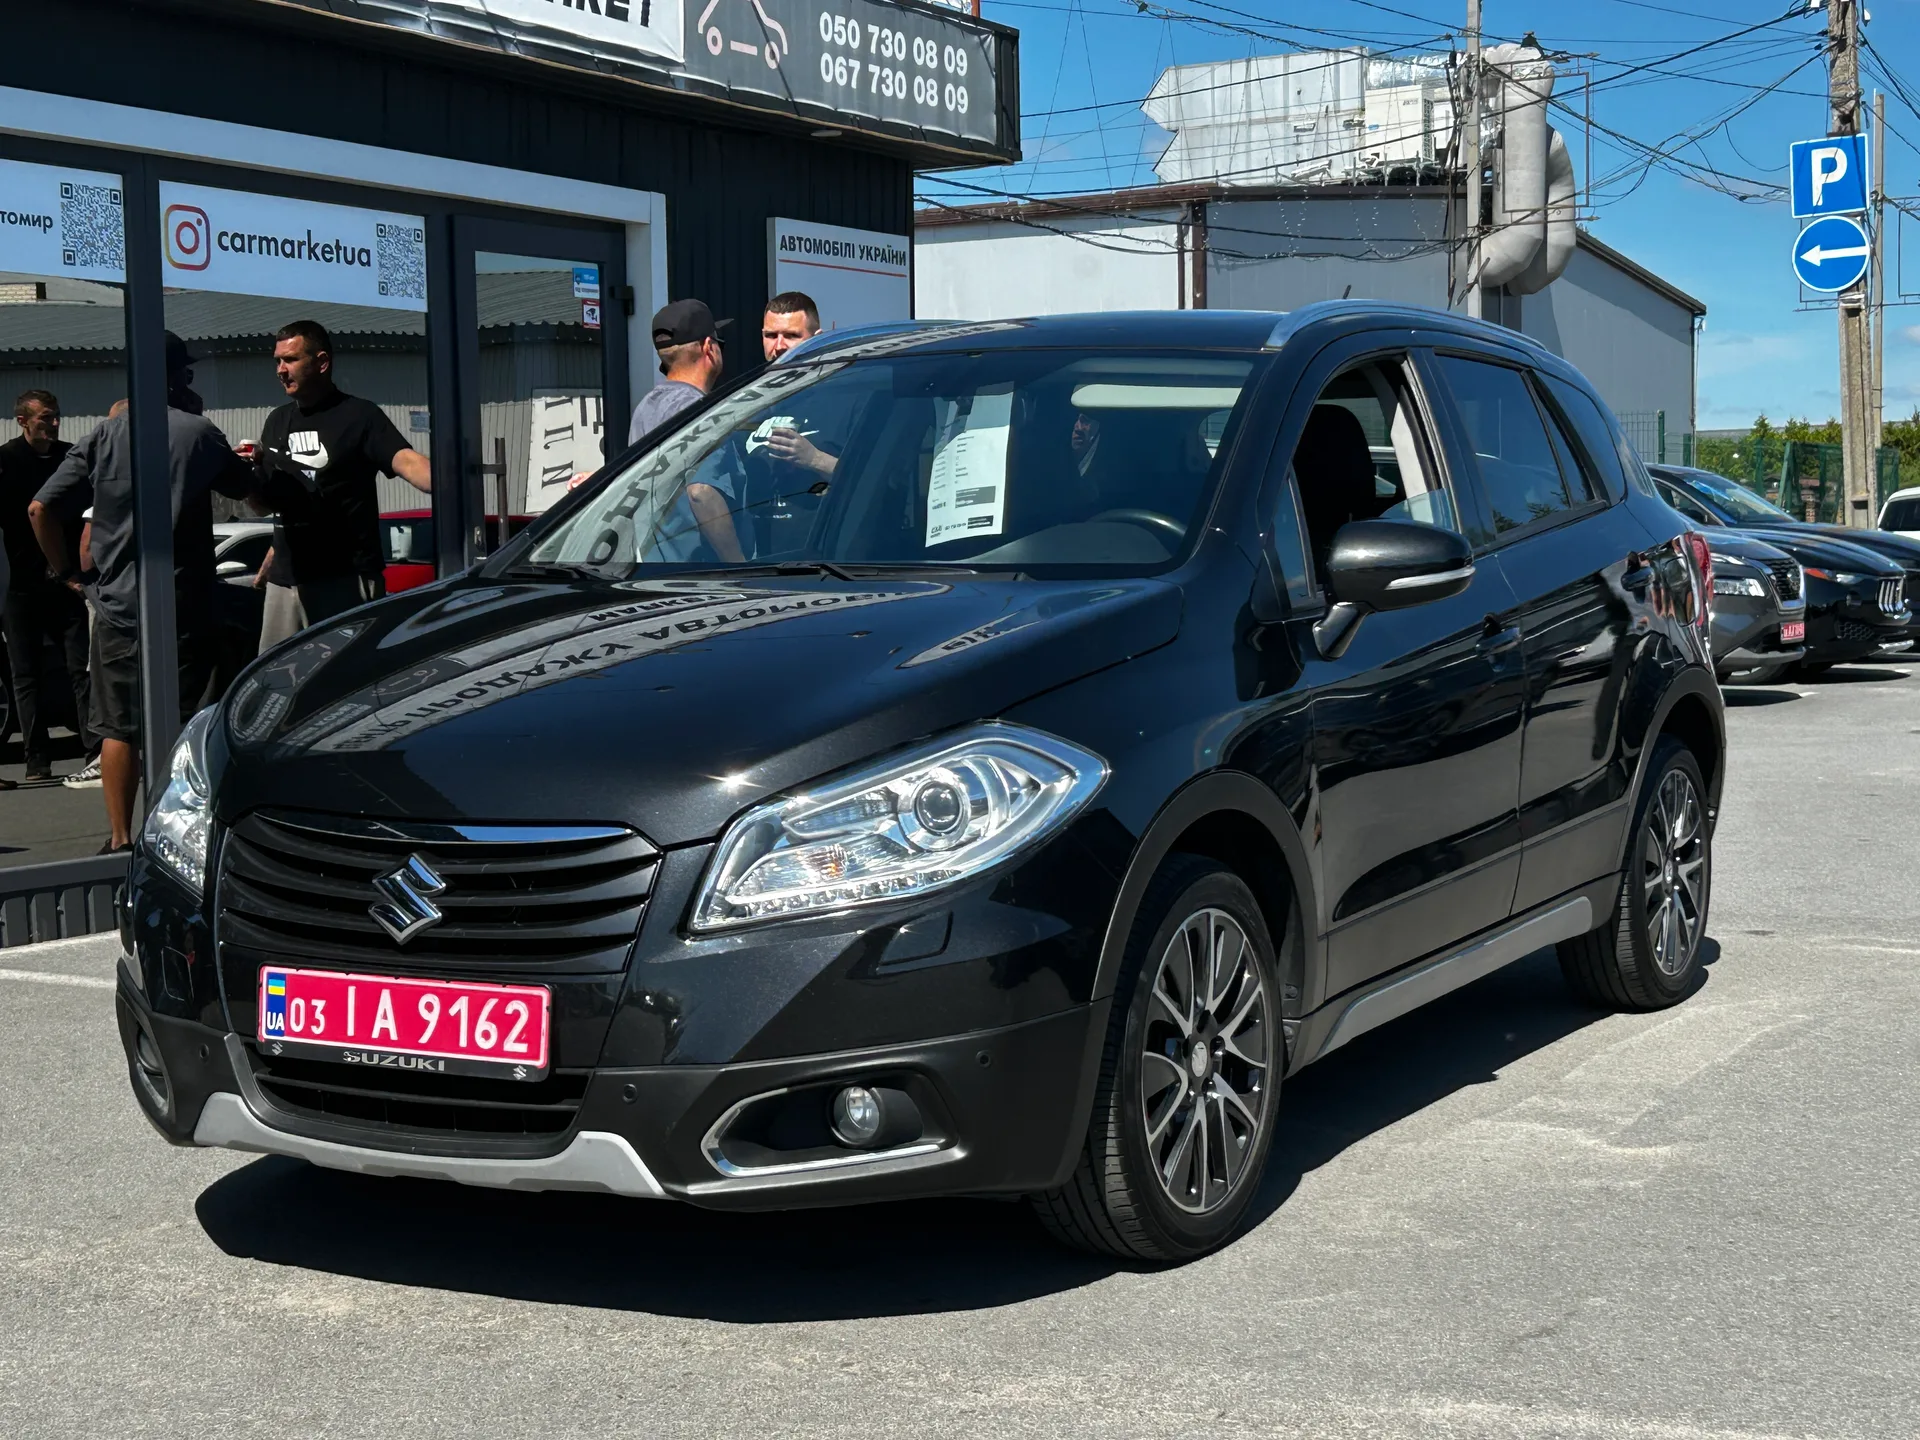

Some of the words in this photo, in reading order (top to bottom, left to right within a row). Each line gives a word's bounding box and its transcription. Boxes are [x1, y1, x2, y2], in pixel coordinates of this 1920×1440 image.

[819, 11, 861, 49] 050
[867, 24, 907, 61] 730
[912, 36, 938, 69] 08
[943, 44, 968, 77] 09
[820, 52, 861, 89] 067
[868, 64, 907, 100] 730
[913, 75, 939, 107] 08
[944, 82, 969, 114] 09
[1811, 147, 1848, 207] P
[217, 229, 372, 267] carmarketua
[779, 234, 856, 259] АВТОМОБІЛІ
[858, 244, 907, 267] УКРАЇНИ
[266, 1010, 285, 1032] UA
[289, 997, 327, 1036] 03
[416, 992, 530, 1054] 9162
[342, 1050, 446, 1072] SUZUKI
